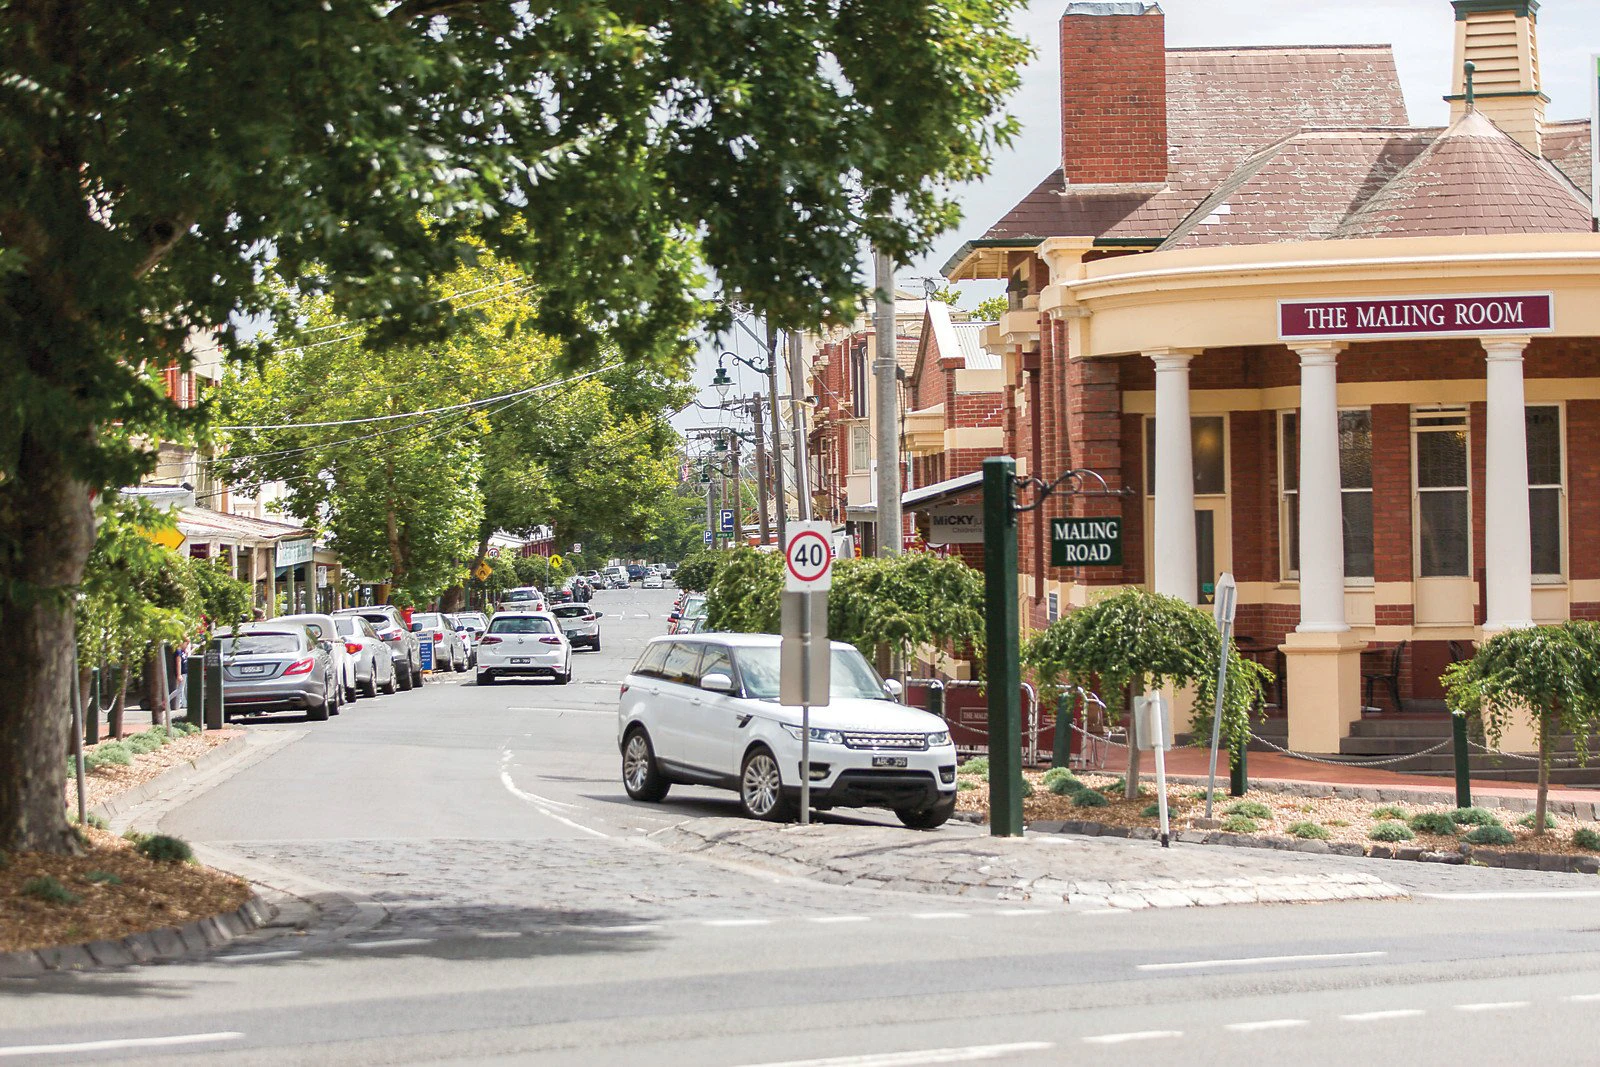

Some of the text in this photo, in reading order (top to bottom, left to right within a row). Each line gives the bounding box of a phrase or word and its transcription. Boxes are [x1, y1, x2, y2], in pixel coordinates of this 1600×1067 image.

[1304, 301, 1524, 329] THE MALING ROOM
[723, 511, 732, 523] P
[705, 531, 711, 539] P
[1054, 521, 1118, 540] MALING
[795, 544, 822, 566] 40
[1066, 543, 1111, 561] ROAD
